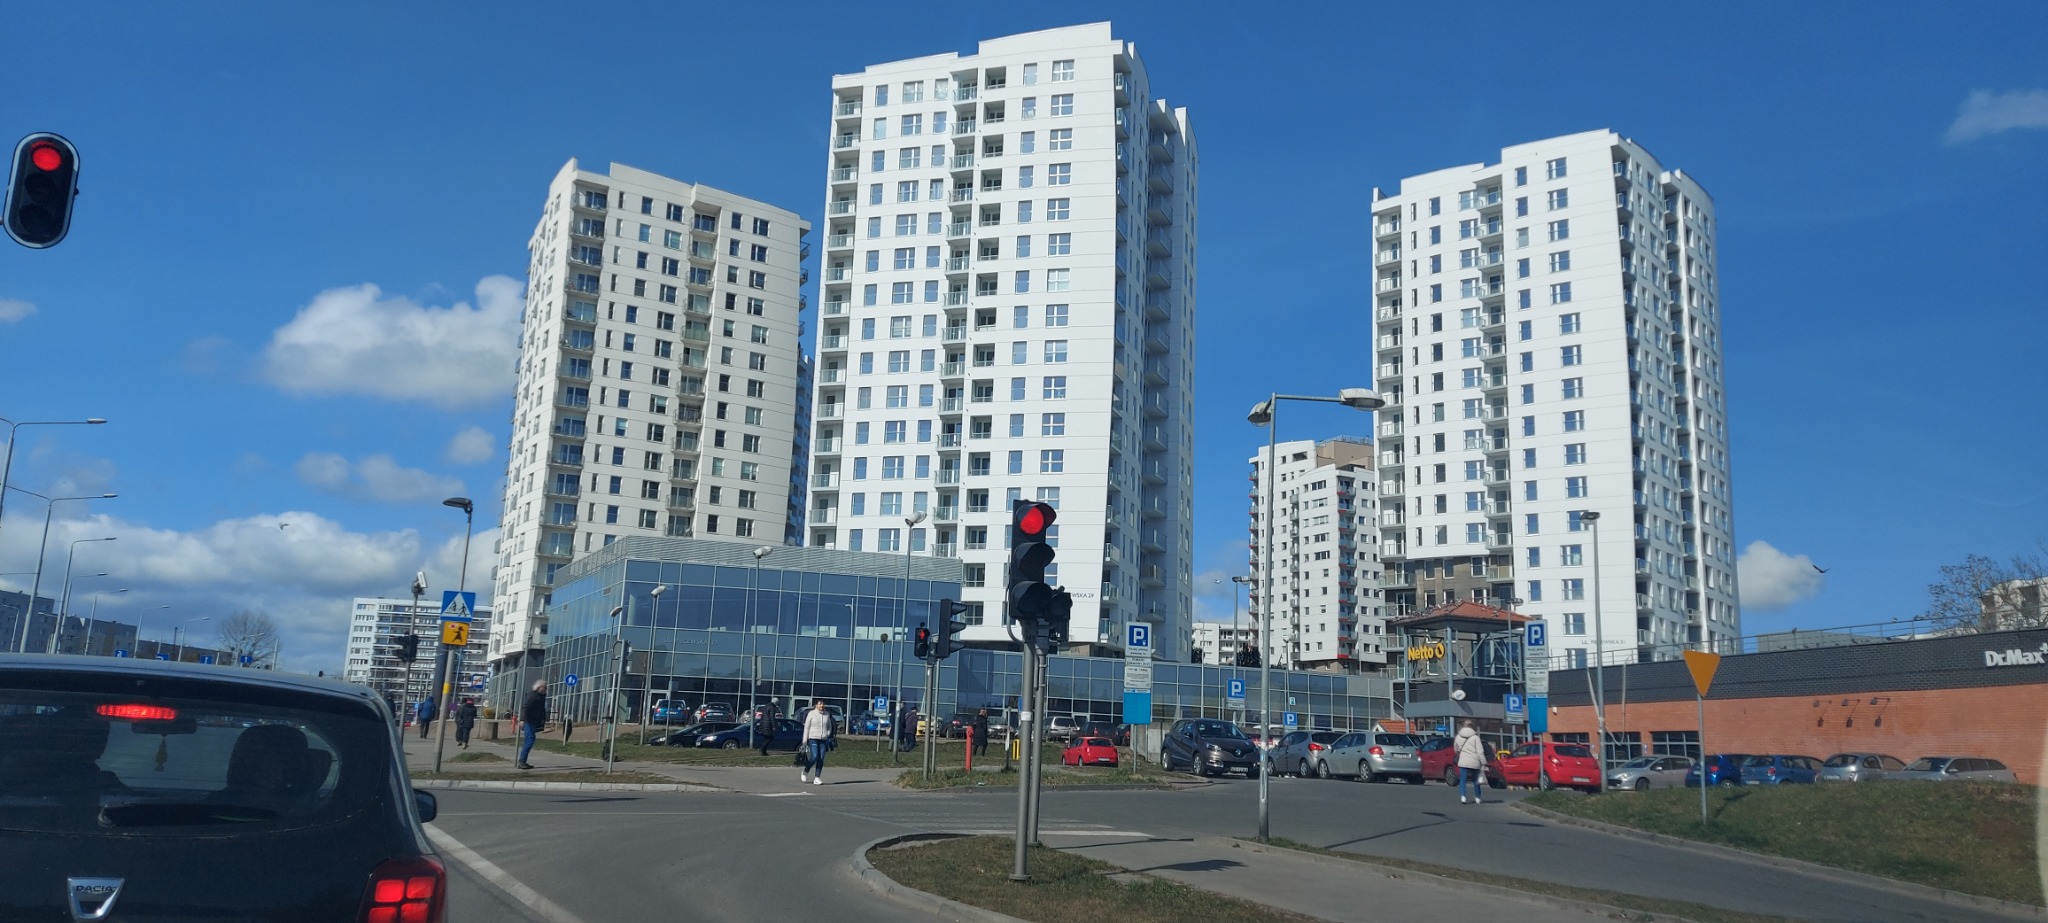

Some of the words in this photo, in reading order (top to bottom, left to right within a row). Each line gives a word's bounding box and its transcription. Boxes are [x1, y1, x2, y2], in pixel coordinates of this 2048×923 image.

[1133, 628, 1144, 643] P
[1531, 626, 1541, 643] P
[1408, 645, 1434, 661] Netto
[1232, 681, 1241, 696] P
[1510, 697, 1519, 711] P
[1287, 713, 1295, 724] P
